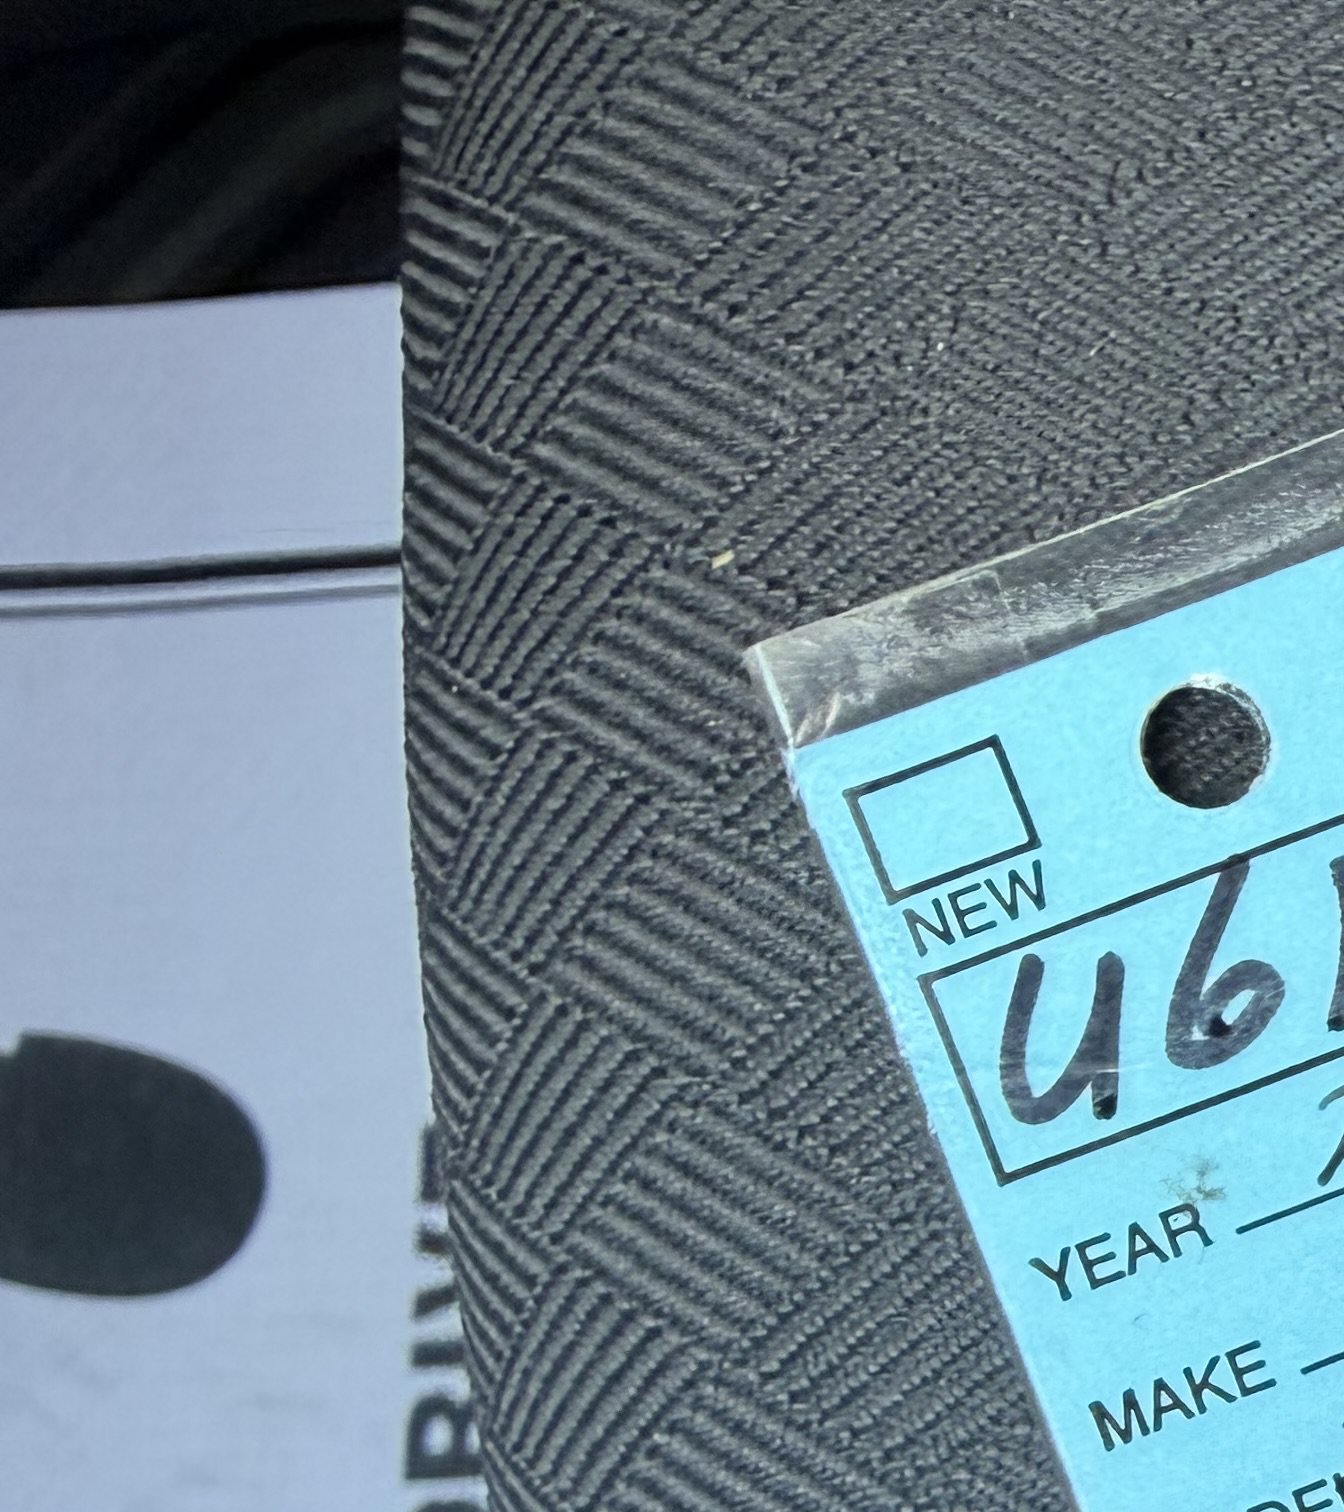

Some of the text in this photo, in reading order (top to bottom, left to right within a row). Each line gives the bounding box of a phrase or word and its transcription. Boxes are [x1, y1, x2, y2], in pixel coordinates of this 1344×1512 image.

[902, 860, 1046, 956] NEW
[1029, 1202, 1212, 1302] YEAR
[1089, 1340, 1277, 1452] MAKE
